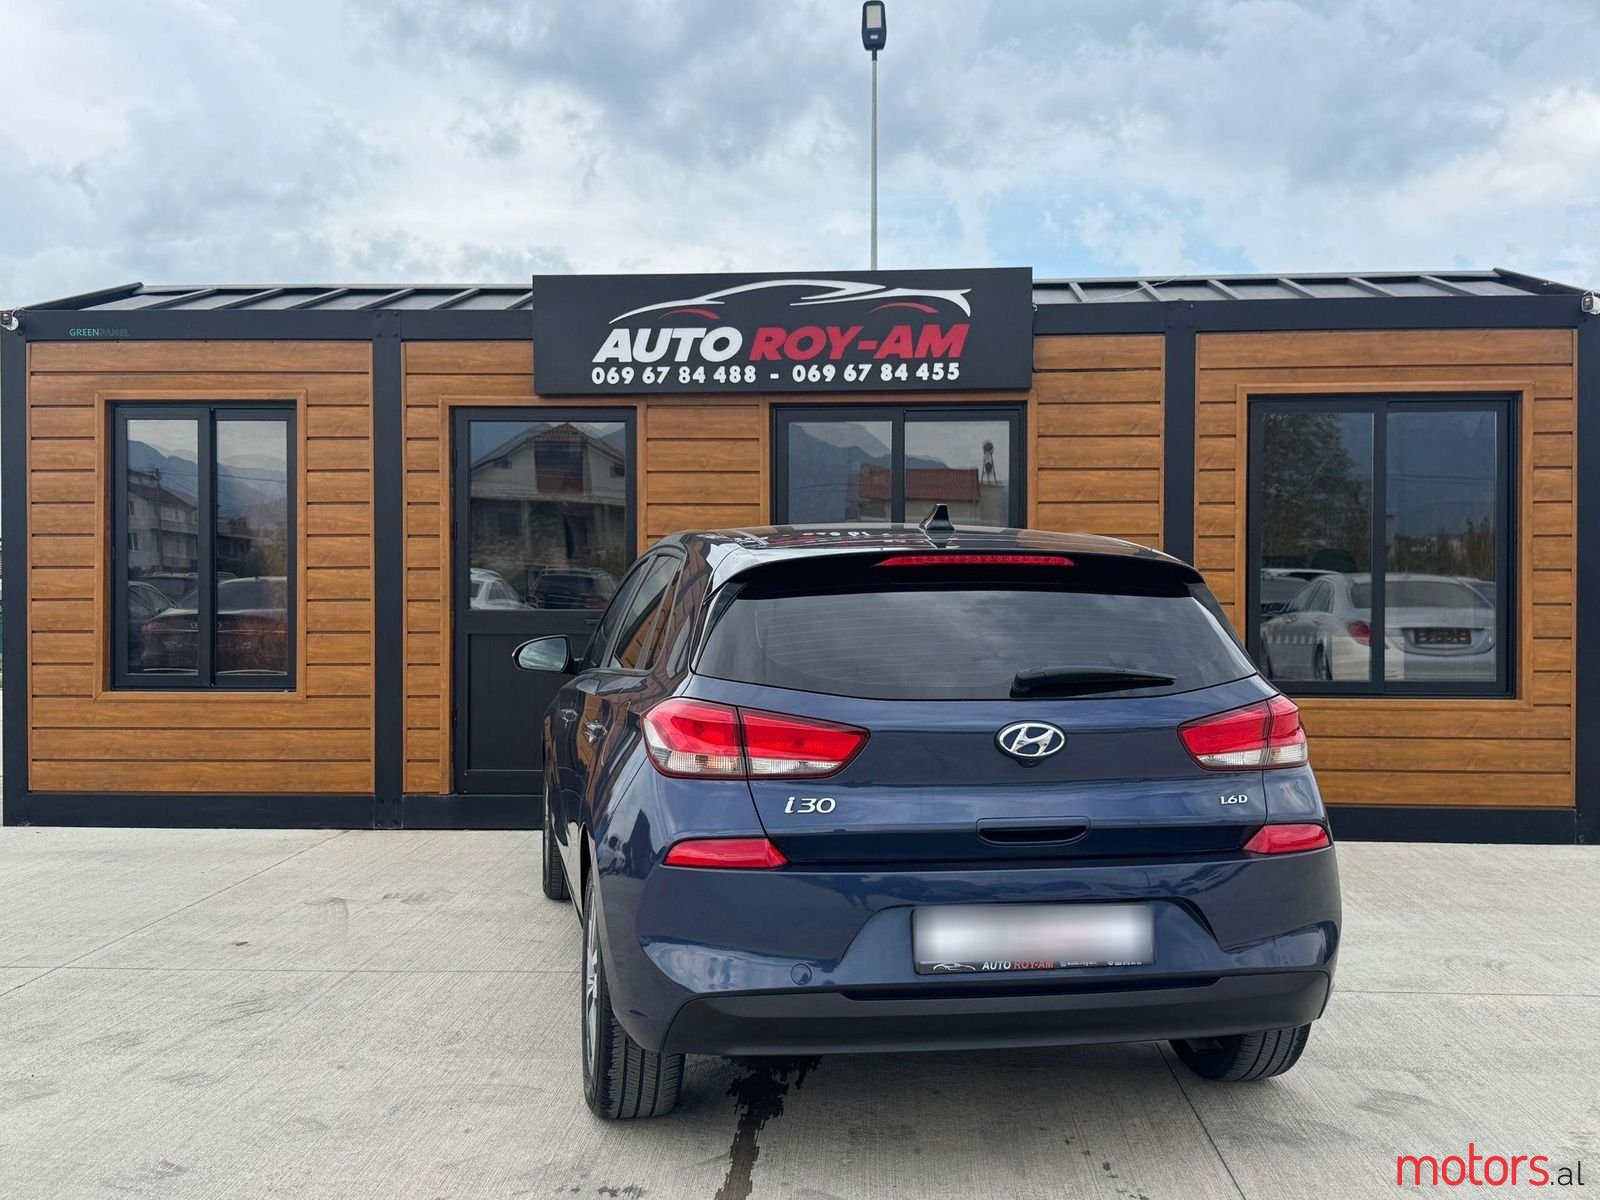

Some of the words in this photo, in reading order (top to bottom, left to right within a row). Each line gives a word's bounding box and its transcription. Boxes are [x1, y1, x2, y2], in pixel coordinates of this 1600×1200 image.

[592, 326, 743, 363] AUTO
[749, 324, 970, 361] ROY-AM
[591, 366, 635, 385] 069
[642, 366, 671, 384] 67
[678, 365, 706, 384] 84
[713, 365, 756, 384] 488
[792, 363, 836, 383] 069
[843, 363, 872, 382] 67
[880, 363, 908, 382] 84
[916, 362, 960, 381] 455
[784, 796, 836, 814] i30
[982, 961, 1011, 970] AUTO
[1014, 960, 1054, 969] ROY-AM
